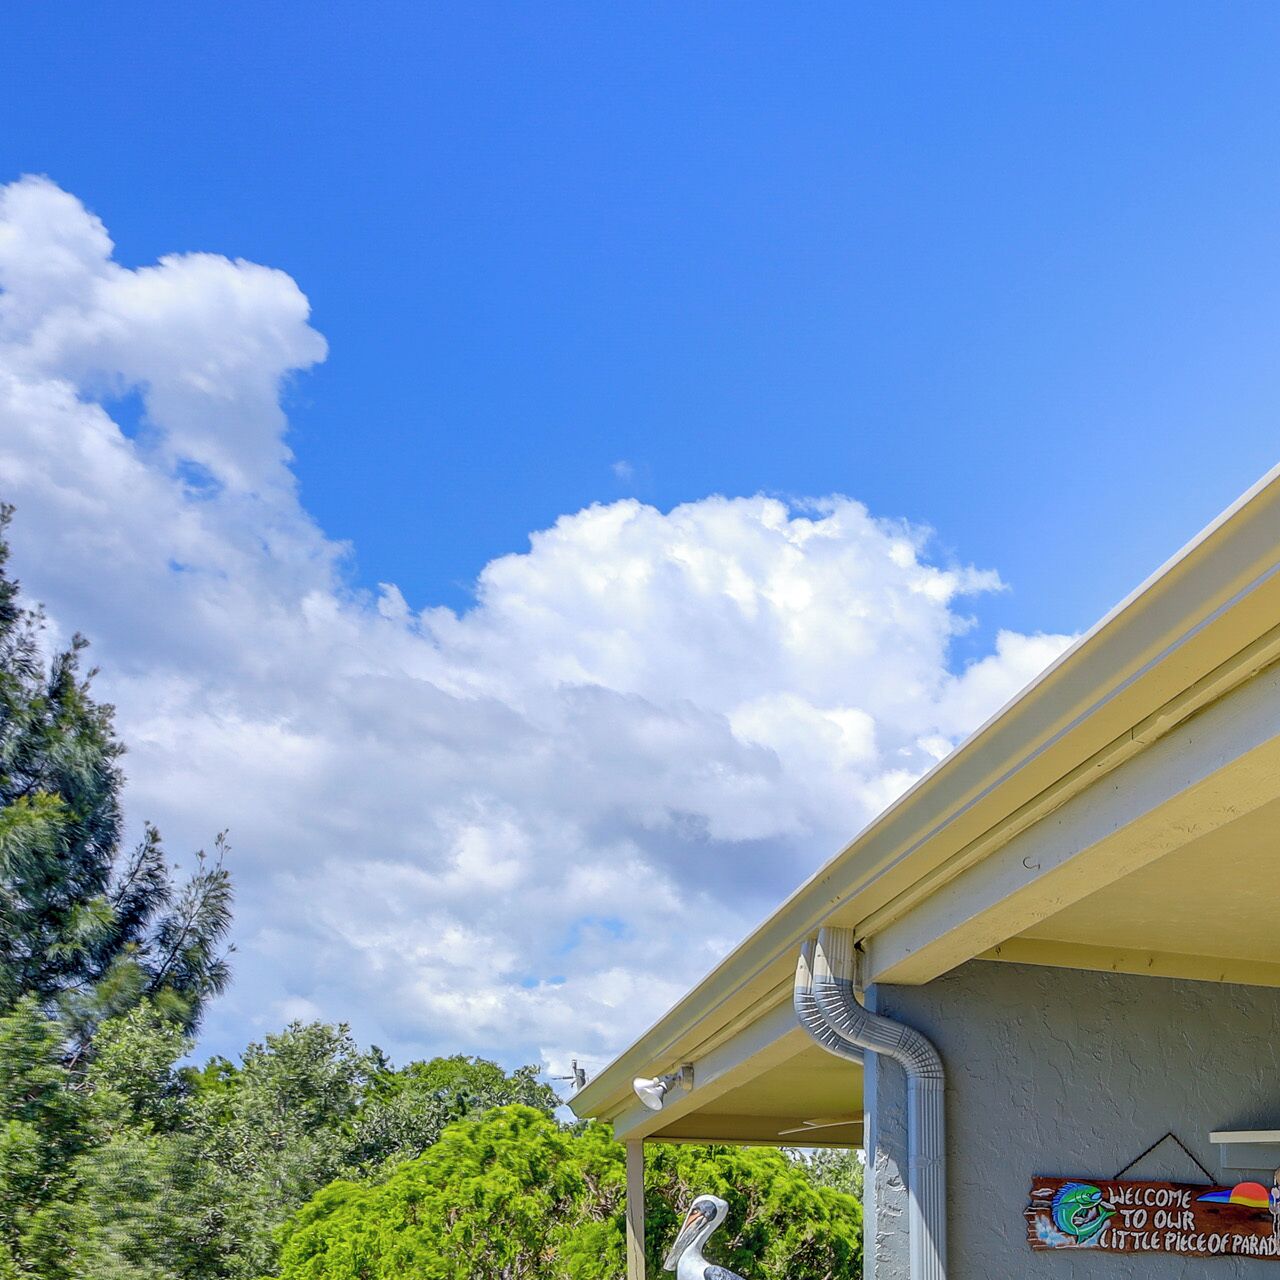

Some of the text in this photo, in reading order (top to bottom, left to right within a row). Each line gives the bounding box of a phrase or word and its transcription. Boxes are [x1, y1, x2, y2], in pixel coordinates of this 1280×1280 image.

[1107, 1185, 1192, 1209] WELCOME
[1119, 1208, 1196, 1231] TO OUR
[1207, 1233, 1230, 1254] OF
